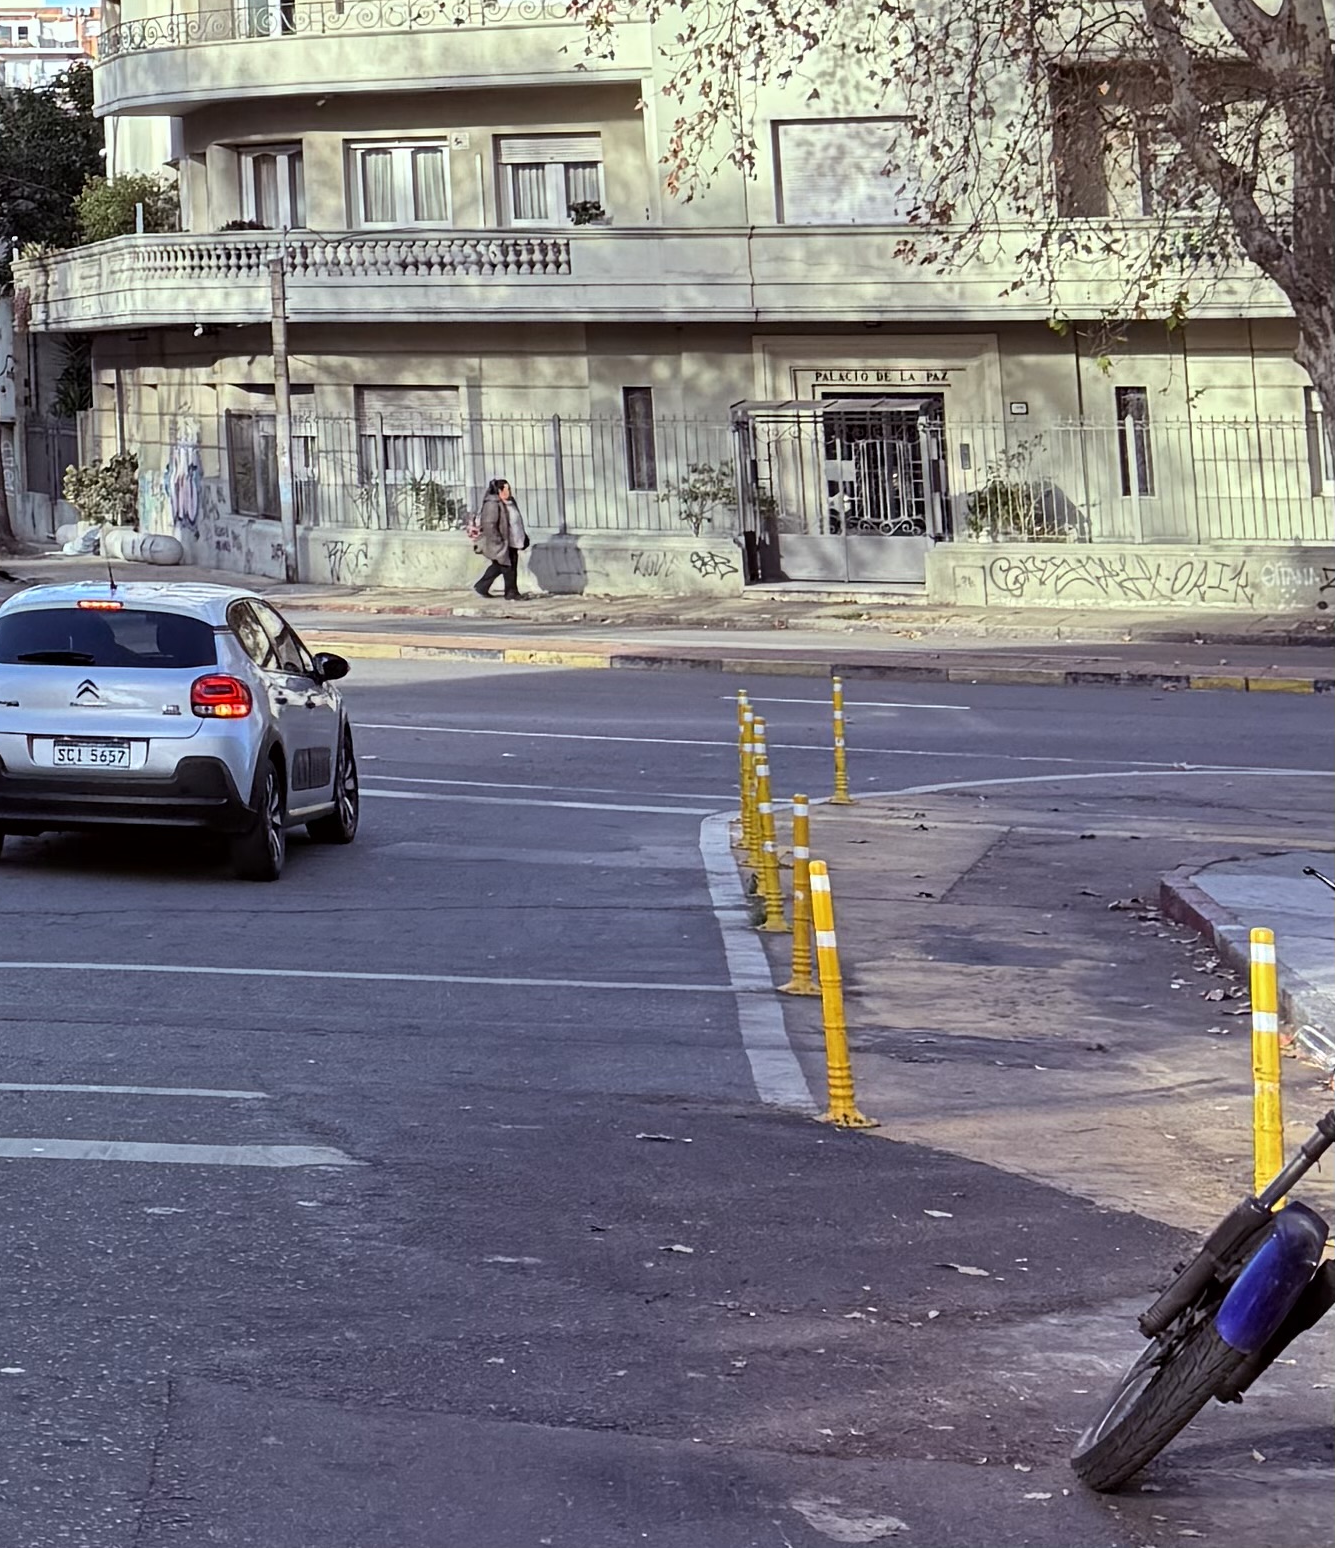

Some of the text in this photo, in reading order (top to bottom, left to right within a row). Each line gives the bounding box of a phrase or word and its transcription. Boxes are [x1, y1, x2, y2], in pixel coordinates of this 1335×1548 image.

[815, 370, 949, 382] PALACIO DE LA PAZ
[90, 749, 126, 764] 5657
